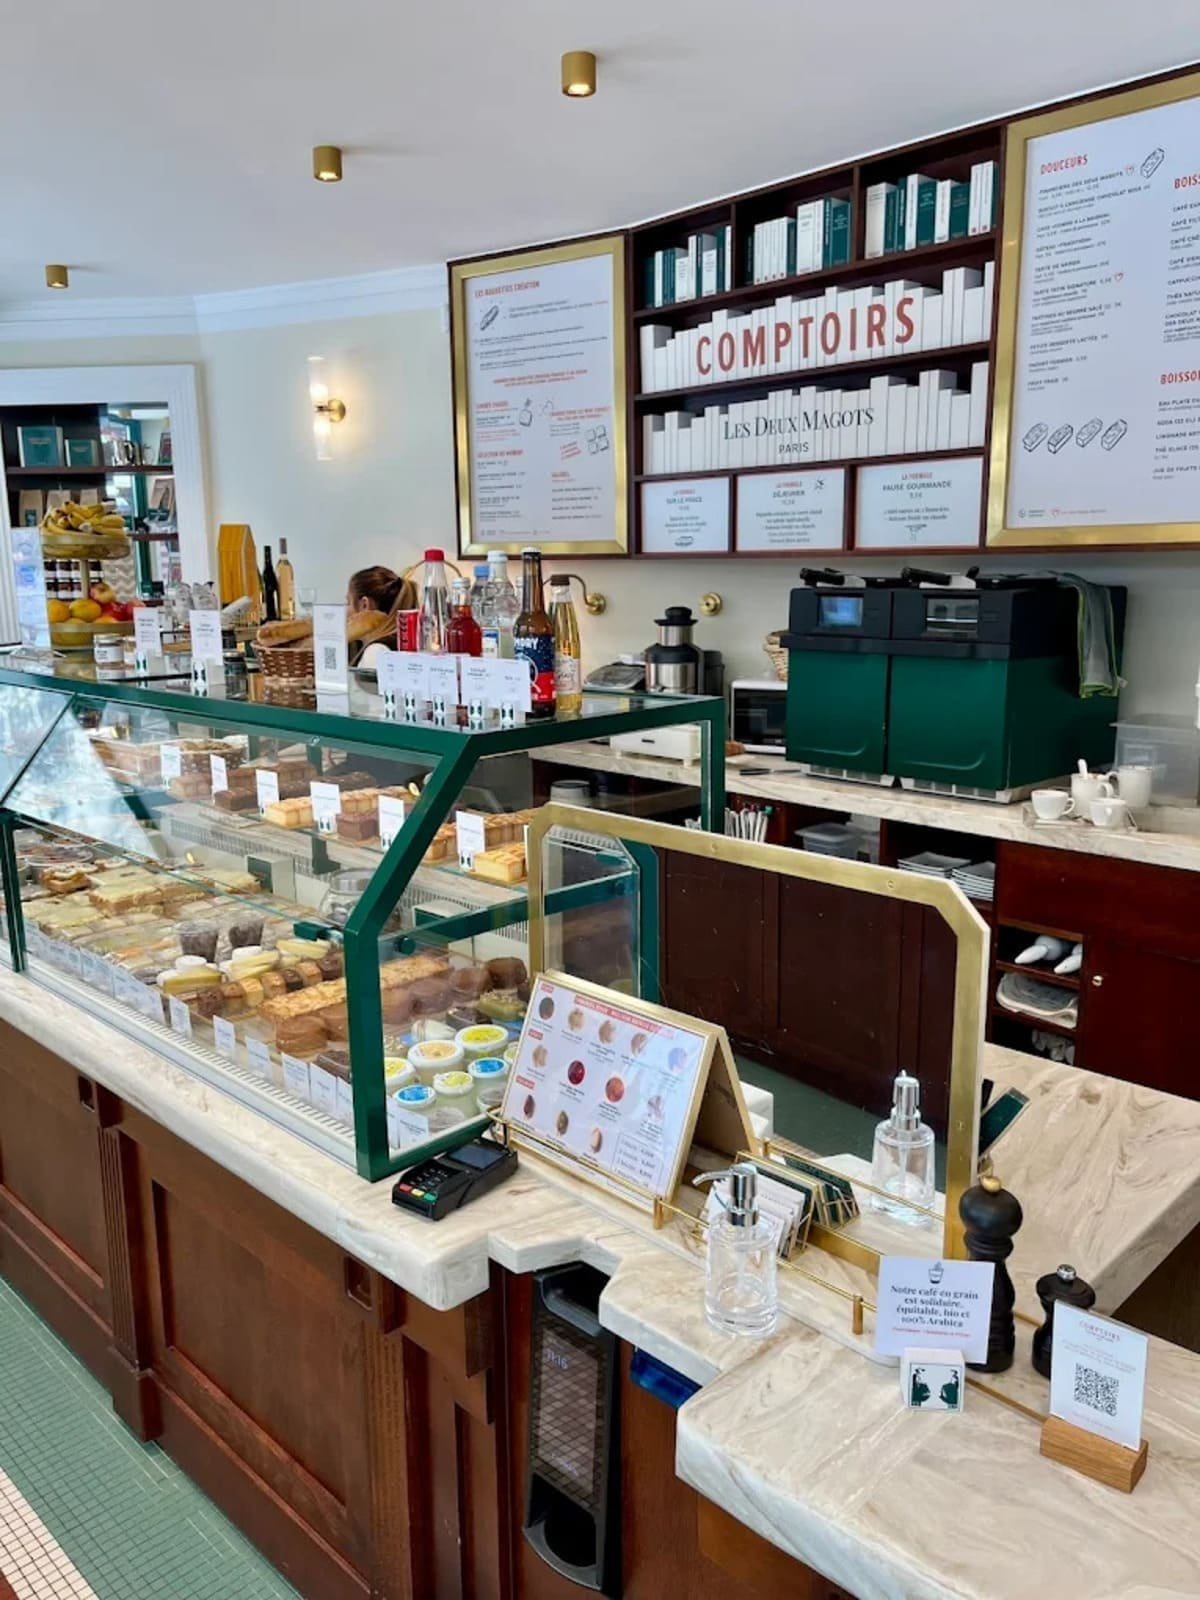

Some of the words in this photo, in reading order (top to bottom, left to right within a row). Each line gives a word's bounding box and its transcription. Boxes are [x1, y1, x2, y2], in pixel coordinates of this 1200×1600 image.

[1040, 154, 1088, 175] DOUCEURS
[696, 297, 914, 375] COMPTOIRS
[723, 420, 751, 440] LES
[755, 416, 798, 437] DEUX
[802, 408, 875, 431] MAGOTS
[779, 442, 809, 454] PARIS
[906, 480, 952, 490] GOURMANDE
[772, 489, 805, 498] DÉJEUNER
[891, 1285, 917, 1295] Notre
[918, 1286, 938, 1296] café
[953, 1290, 979, 1300] grain
[896, 1305, 942, 1317] équitable,
[943, 1308, 960, 1318] bio
[960, 1310, 970, 1318] et
[901, 1315, 926, 1325] 100%
[926, 1316, 964, 1328] Arabica
